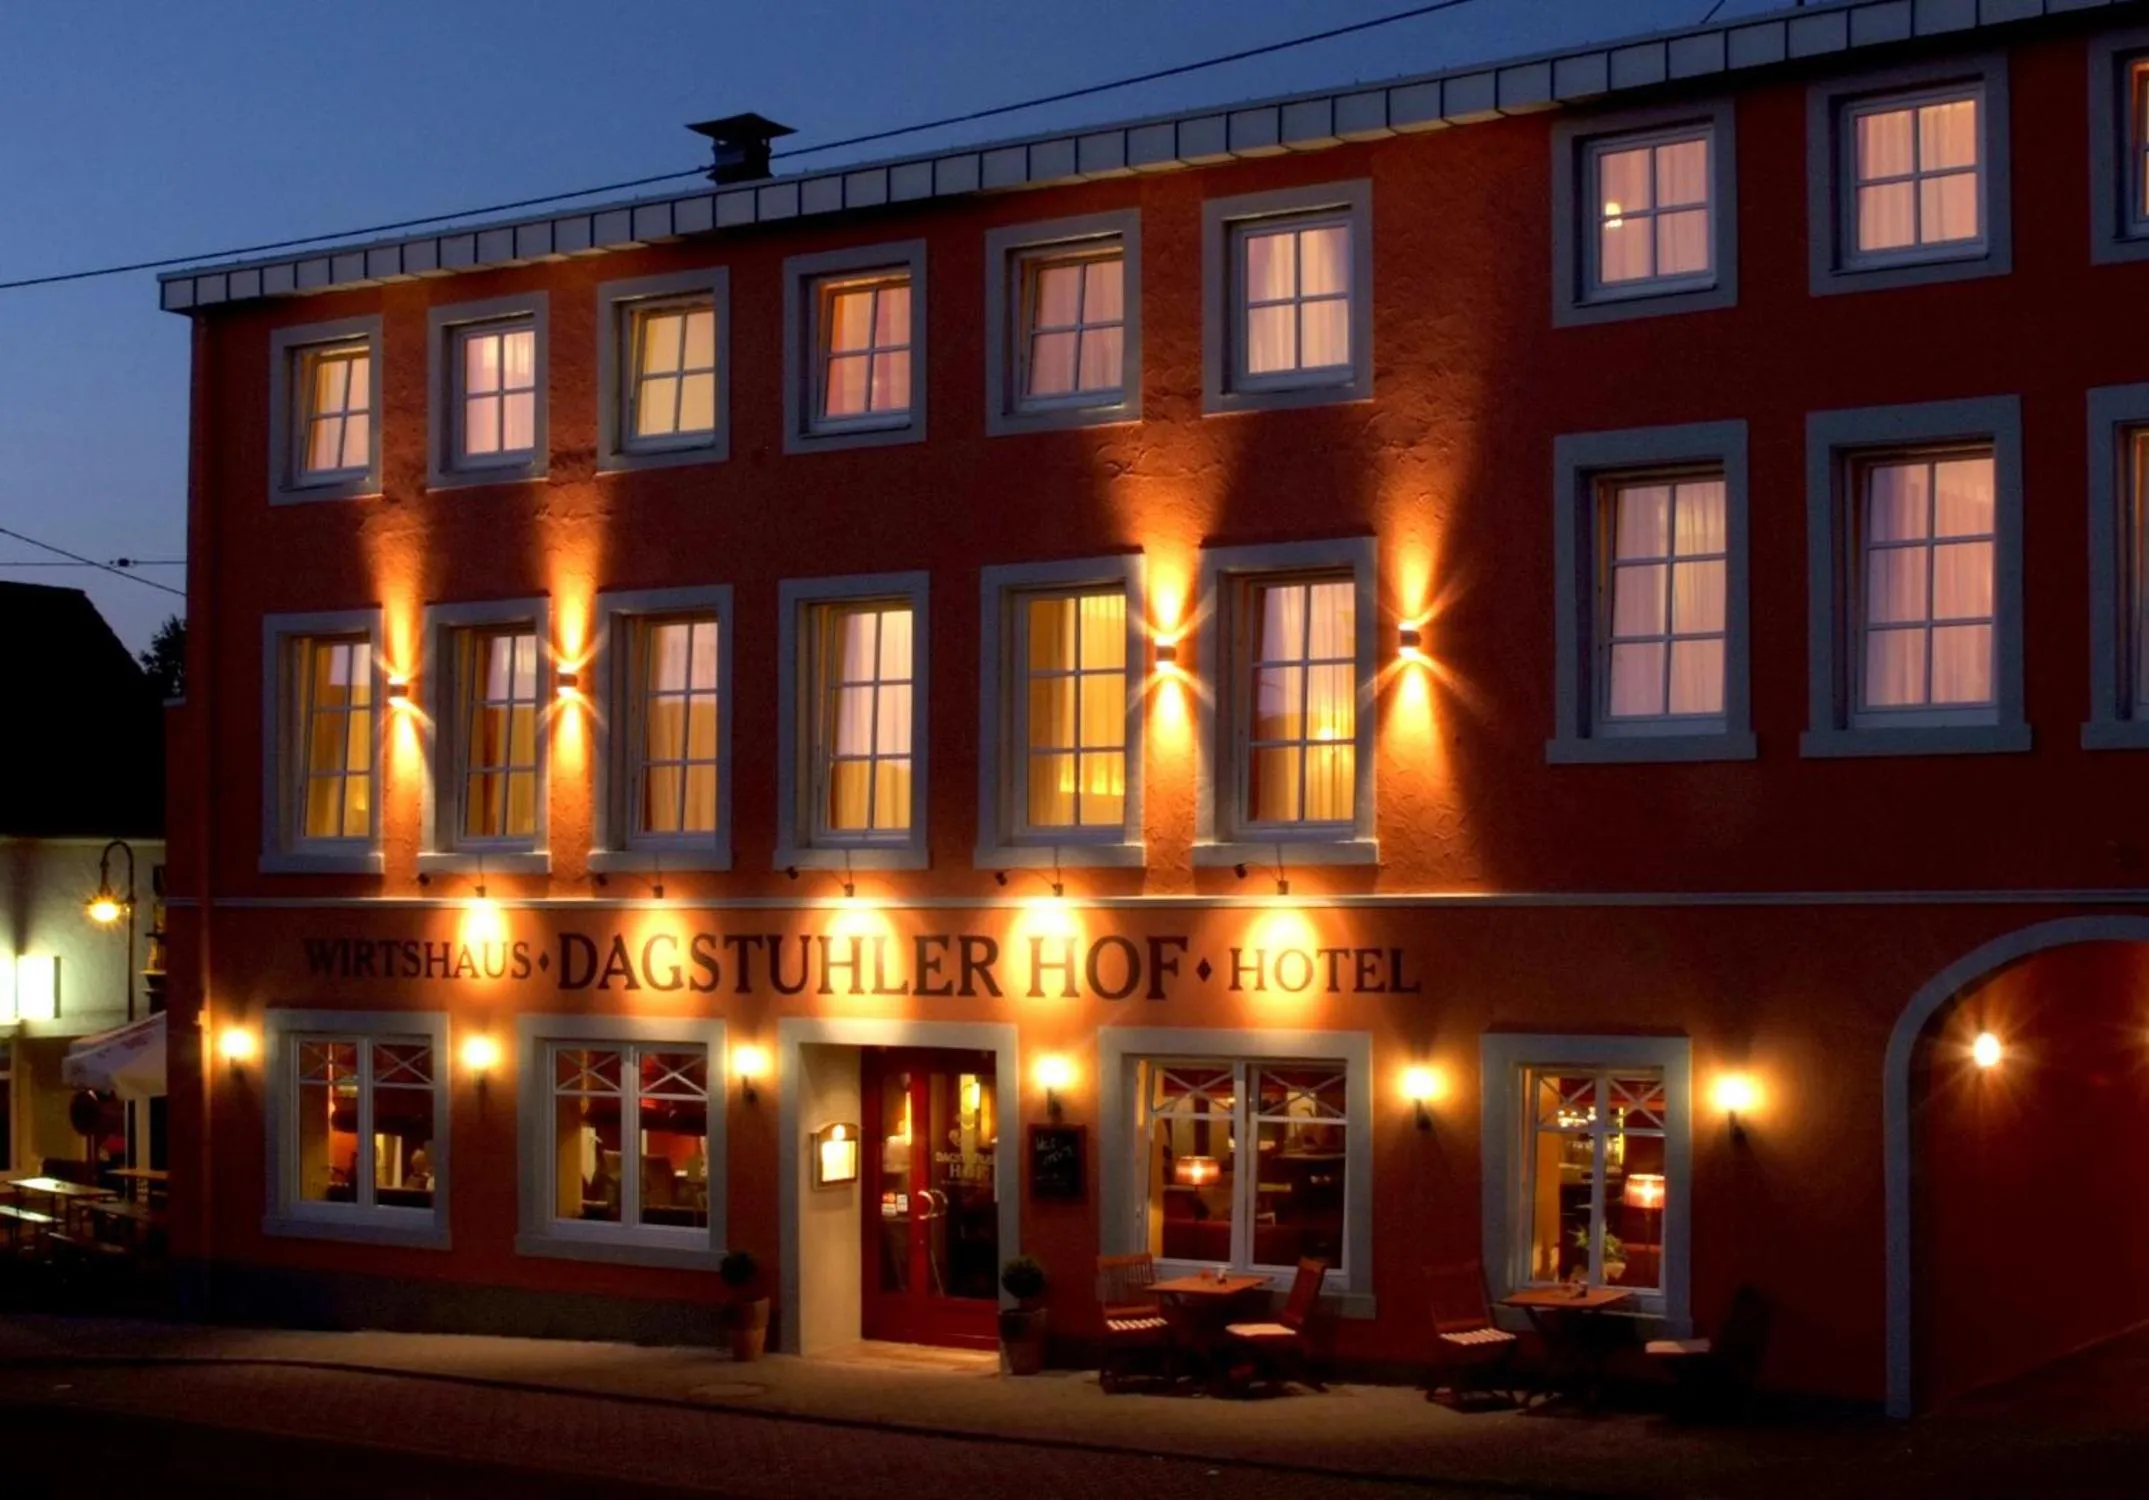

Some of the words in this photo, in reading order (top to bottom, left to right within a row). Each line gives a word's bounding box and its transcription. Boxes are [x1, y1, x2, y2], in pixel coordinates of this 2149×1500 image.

[306, 939, 530, 980] WIRTSHAUS
[557, 933, 1003, 997] DAGSTUHLER
[1026, 935, 1188, 999] HOF
[1229, 947, 1421, 993] HOTEL
